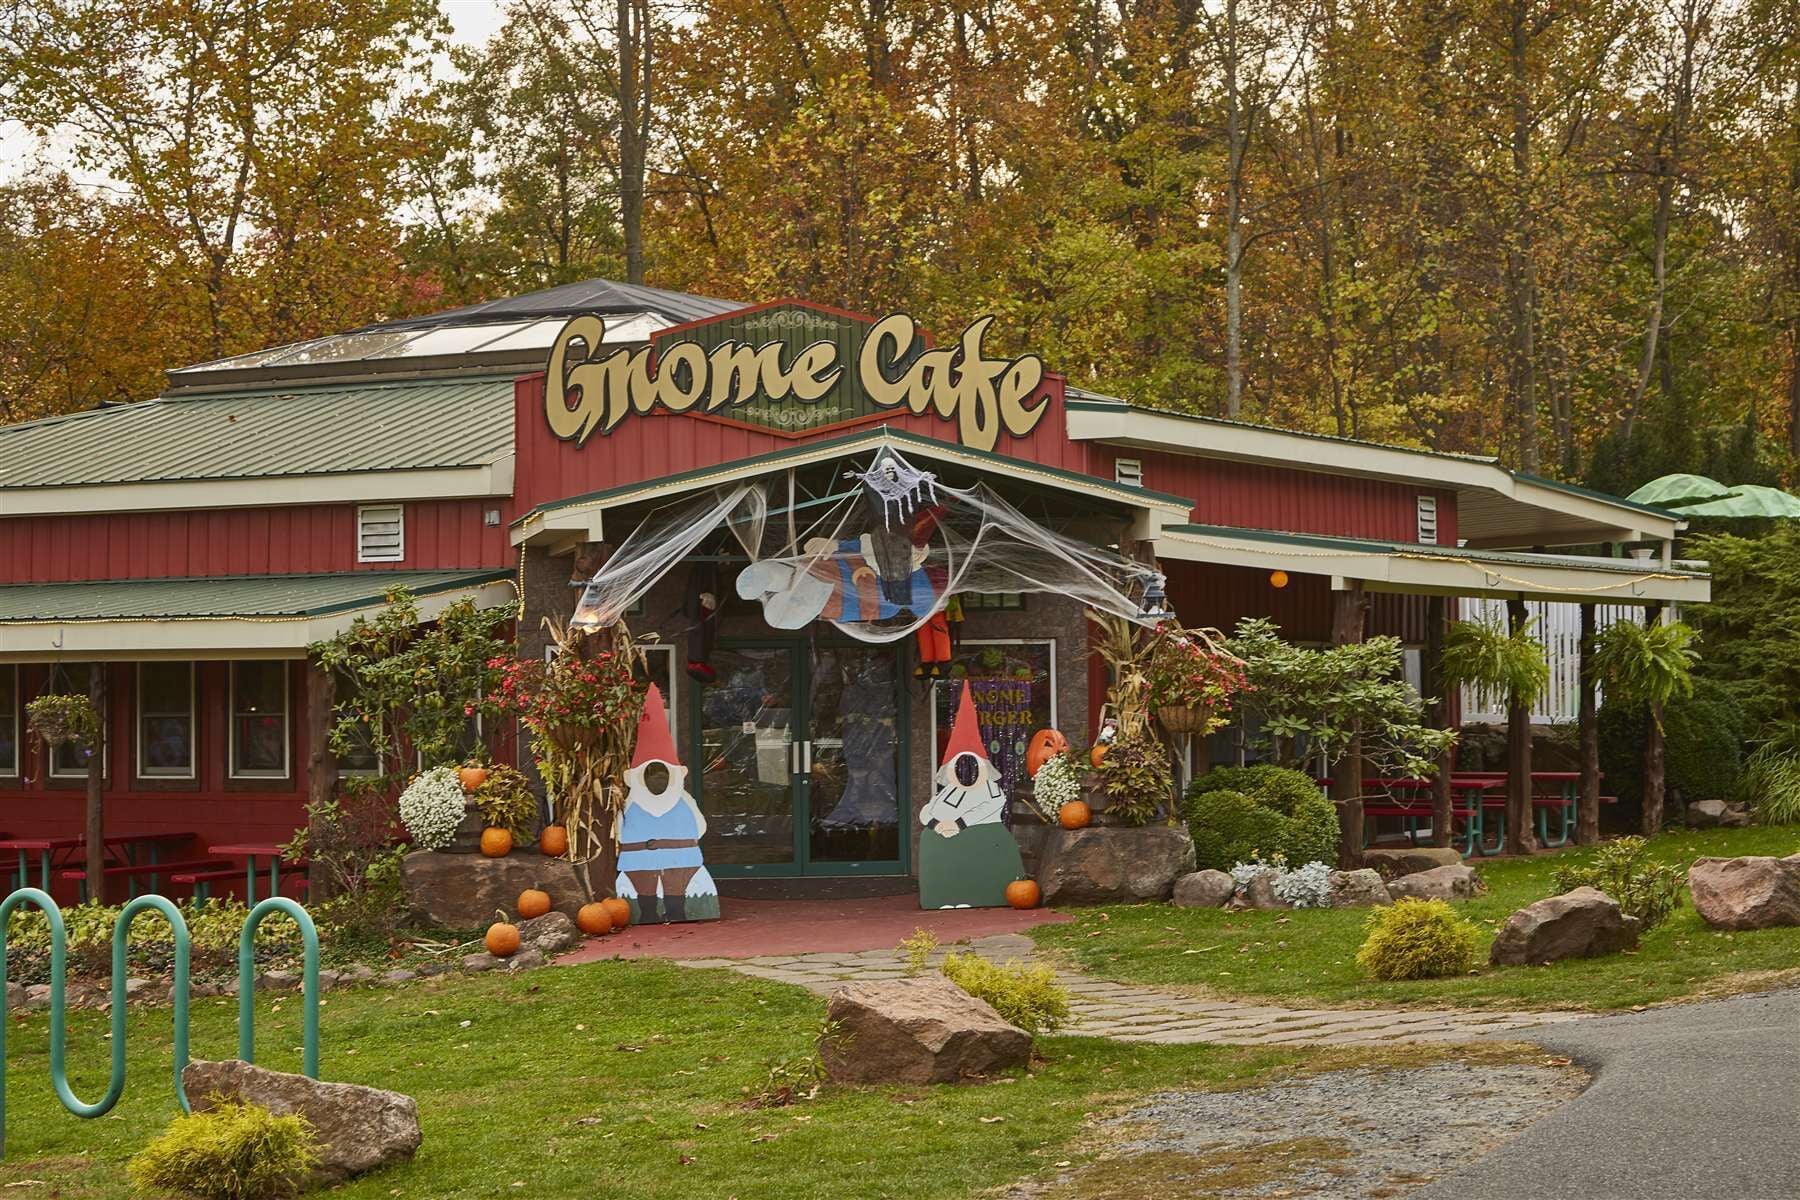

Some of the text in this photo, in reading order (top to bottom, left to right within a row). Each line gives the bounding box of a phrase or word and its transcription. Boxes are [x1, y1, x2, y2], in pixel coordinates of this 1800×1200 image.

[545, 312, 1051, 452] Gnome Cafe
[979, 710, 1033, 726] RGER
